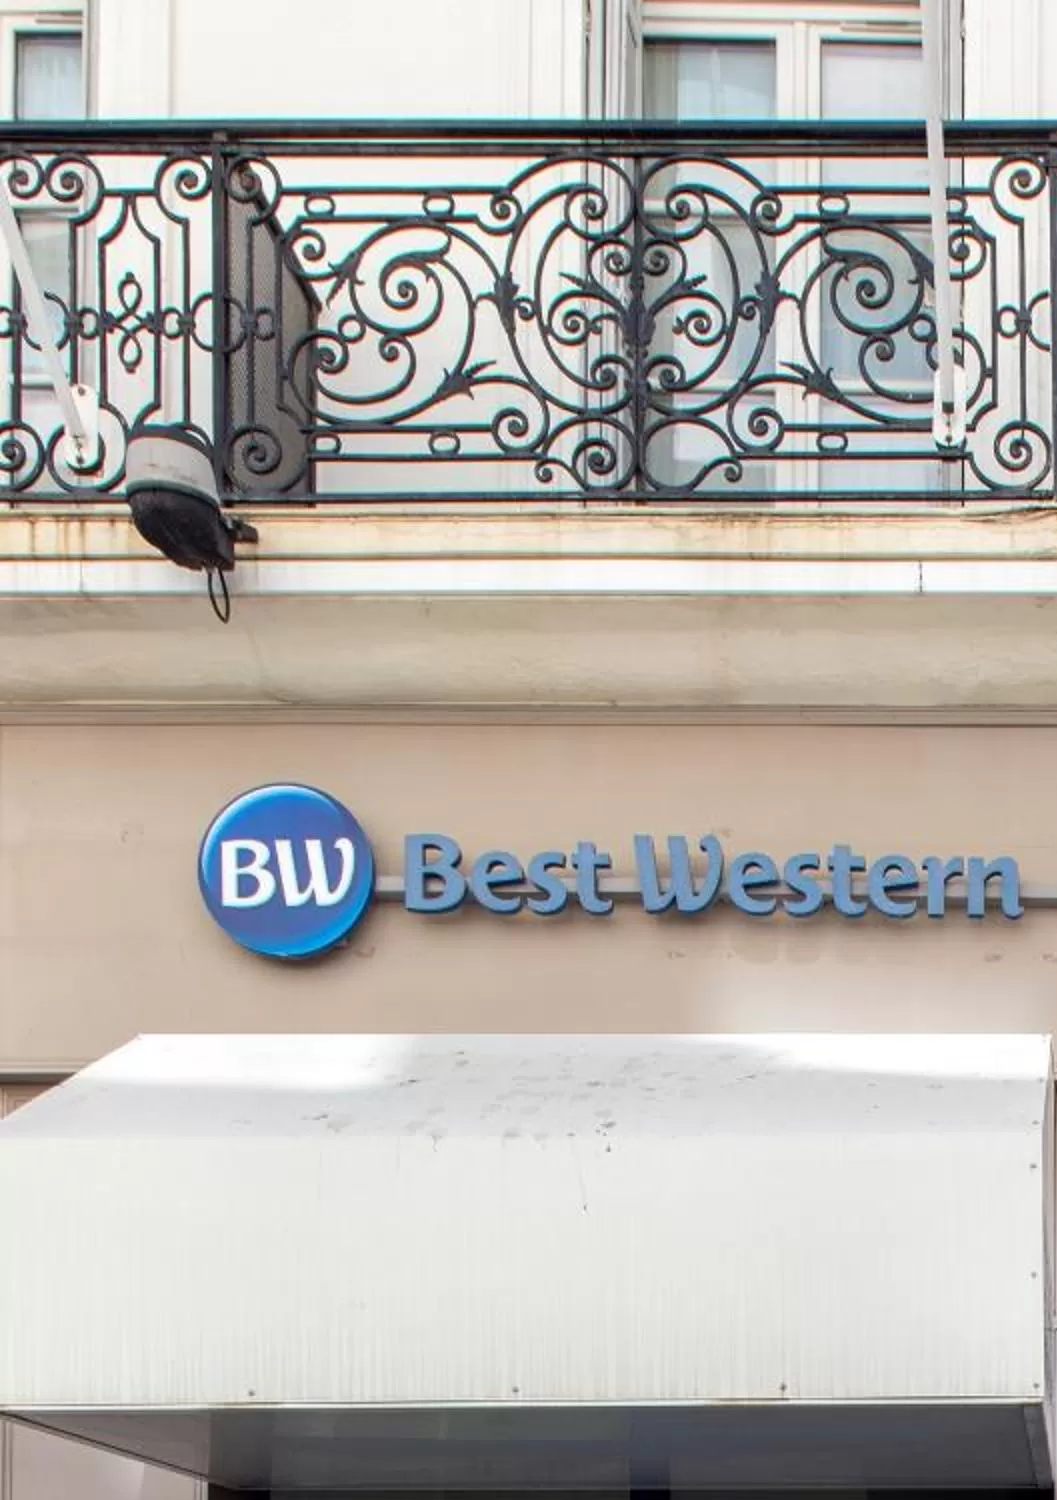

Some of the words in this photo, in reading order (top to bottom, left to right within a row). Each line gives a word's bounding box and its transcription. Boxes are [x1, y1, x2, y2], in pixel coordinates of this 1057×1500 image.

[220, 836, 356, 908] BW
[403, 833, 616, 917] Best
[633, 833, 1026, 921] Western
